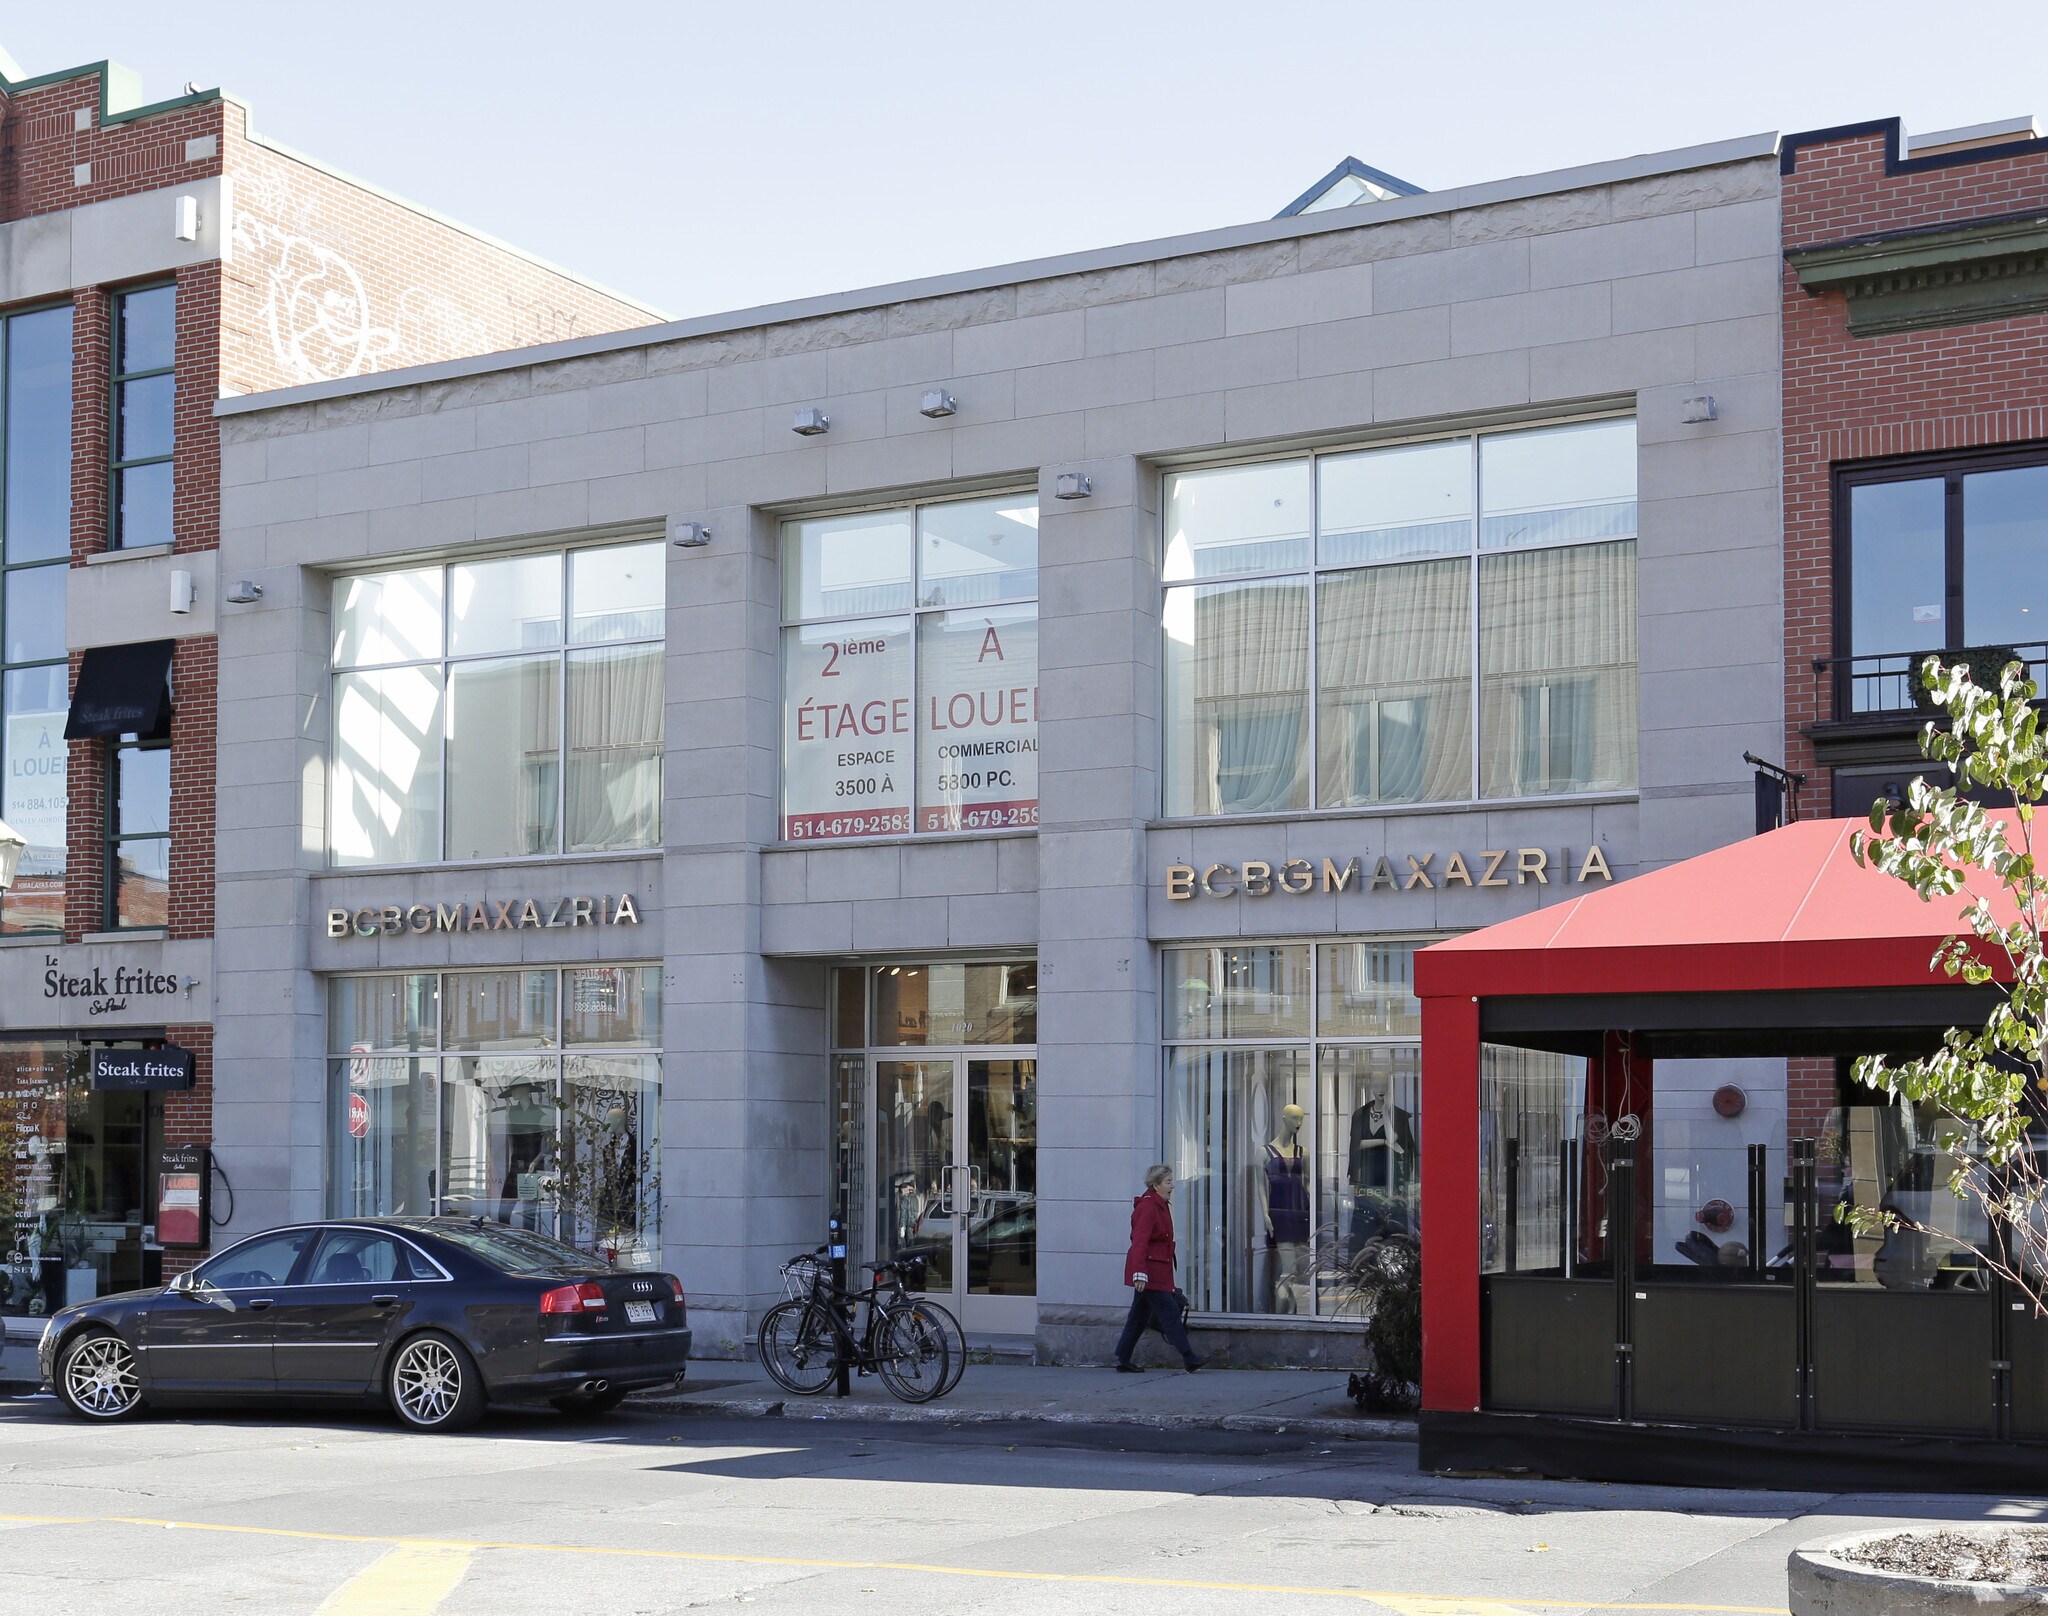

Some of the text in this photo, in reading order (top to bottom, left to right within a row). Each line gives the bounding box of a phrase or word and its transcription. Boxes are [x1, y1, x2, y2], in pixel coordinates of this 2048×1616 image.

[978, 617, 1005, 663] À
[797, 696, 909, 741] ÉTAGE
[930, 686, 1038, 731] LOUE
[837, 750, 895, 767] ESPACE
[938, 738, 1038, 759] COMMERCIAL
[13, 756, 67, 777] LOUE
[835, 773, 894, 797] 3500 À
[987, 769, 1016, 788] PC.
[12, 801, 25, 810] 514
[1166, 845, 1613, 900] BCBGMAXAZRIA
[327, 893, 642, 938] BCBGMAXAZRIA
[45, 955, 58, 967] Le
[44, 966, 178, 998] Steak frites
[952, 1022, 973, 1033] 1020
[97, 1061, 184, 1077] Steak frites
[162, 1153, 198, 1163] Steak frites
